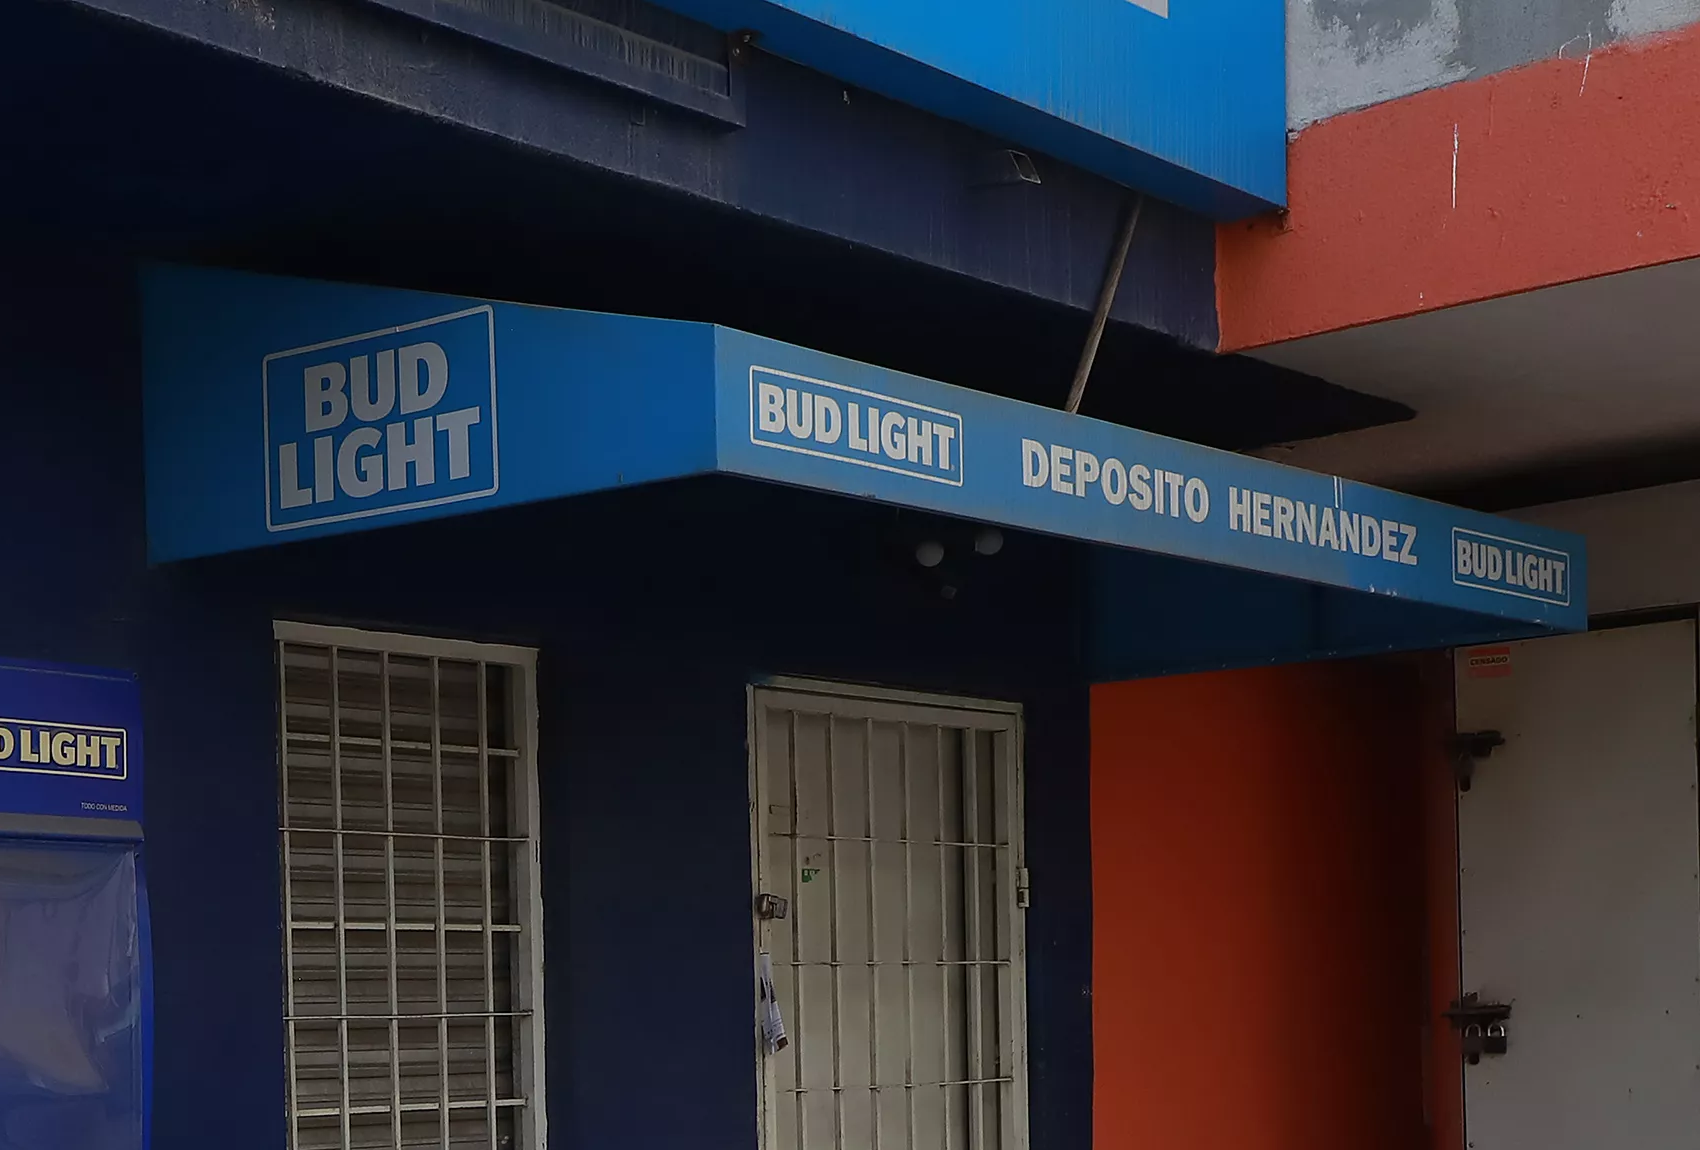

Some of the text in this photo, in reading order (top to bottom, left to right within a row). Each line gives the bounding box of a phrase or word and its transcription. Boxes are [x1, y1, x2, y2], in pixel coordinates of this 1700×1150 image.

[304, 341, 448, 433] BUD
[279, 406, 480, 510] LIGHT
[758, 382, 1565, 595] BUD LIGHT DEPOSITO HERNANDEZ BUD LIGHT
[20, 729, 121, 769] LIGHT
